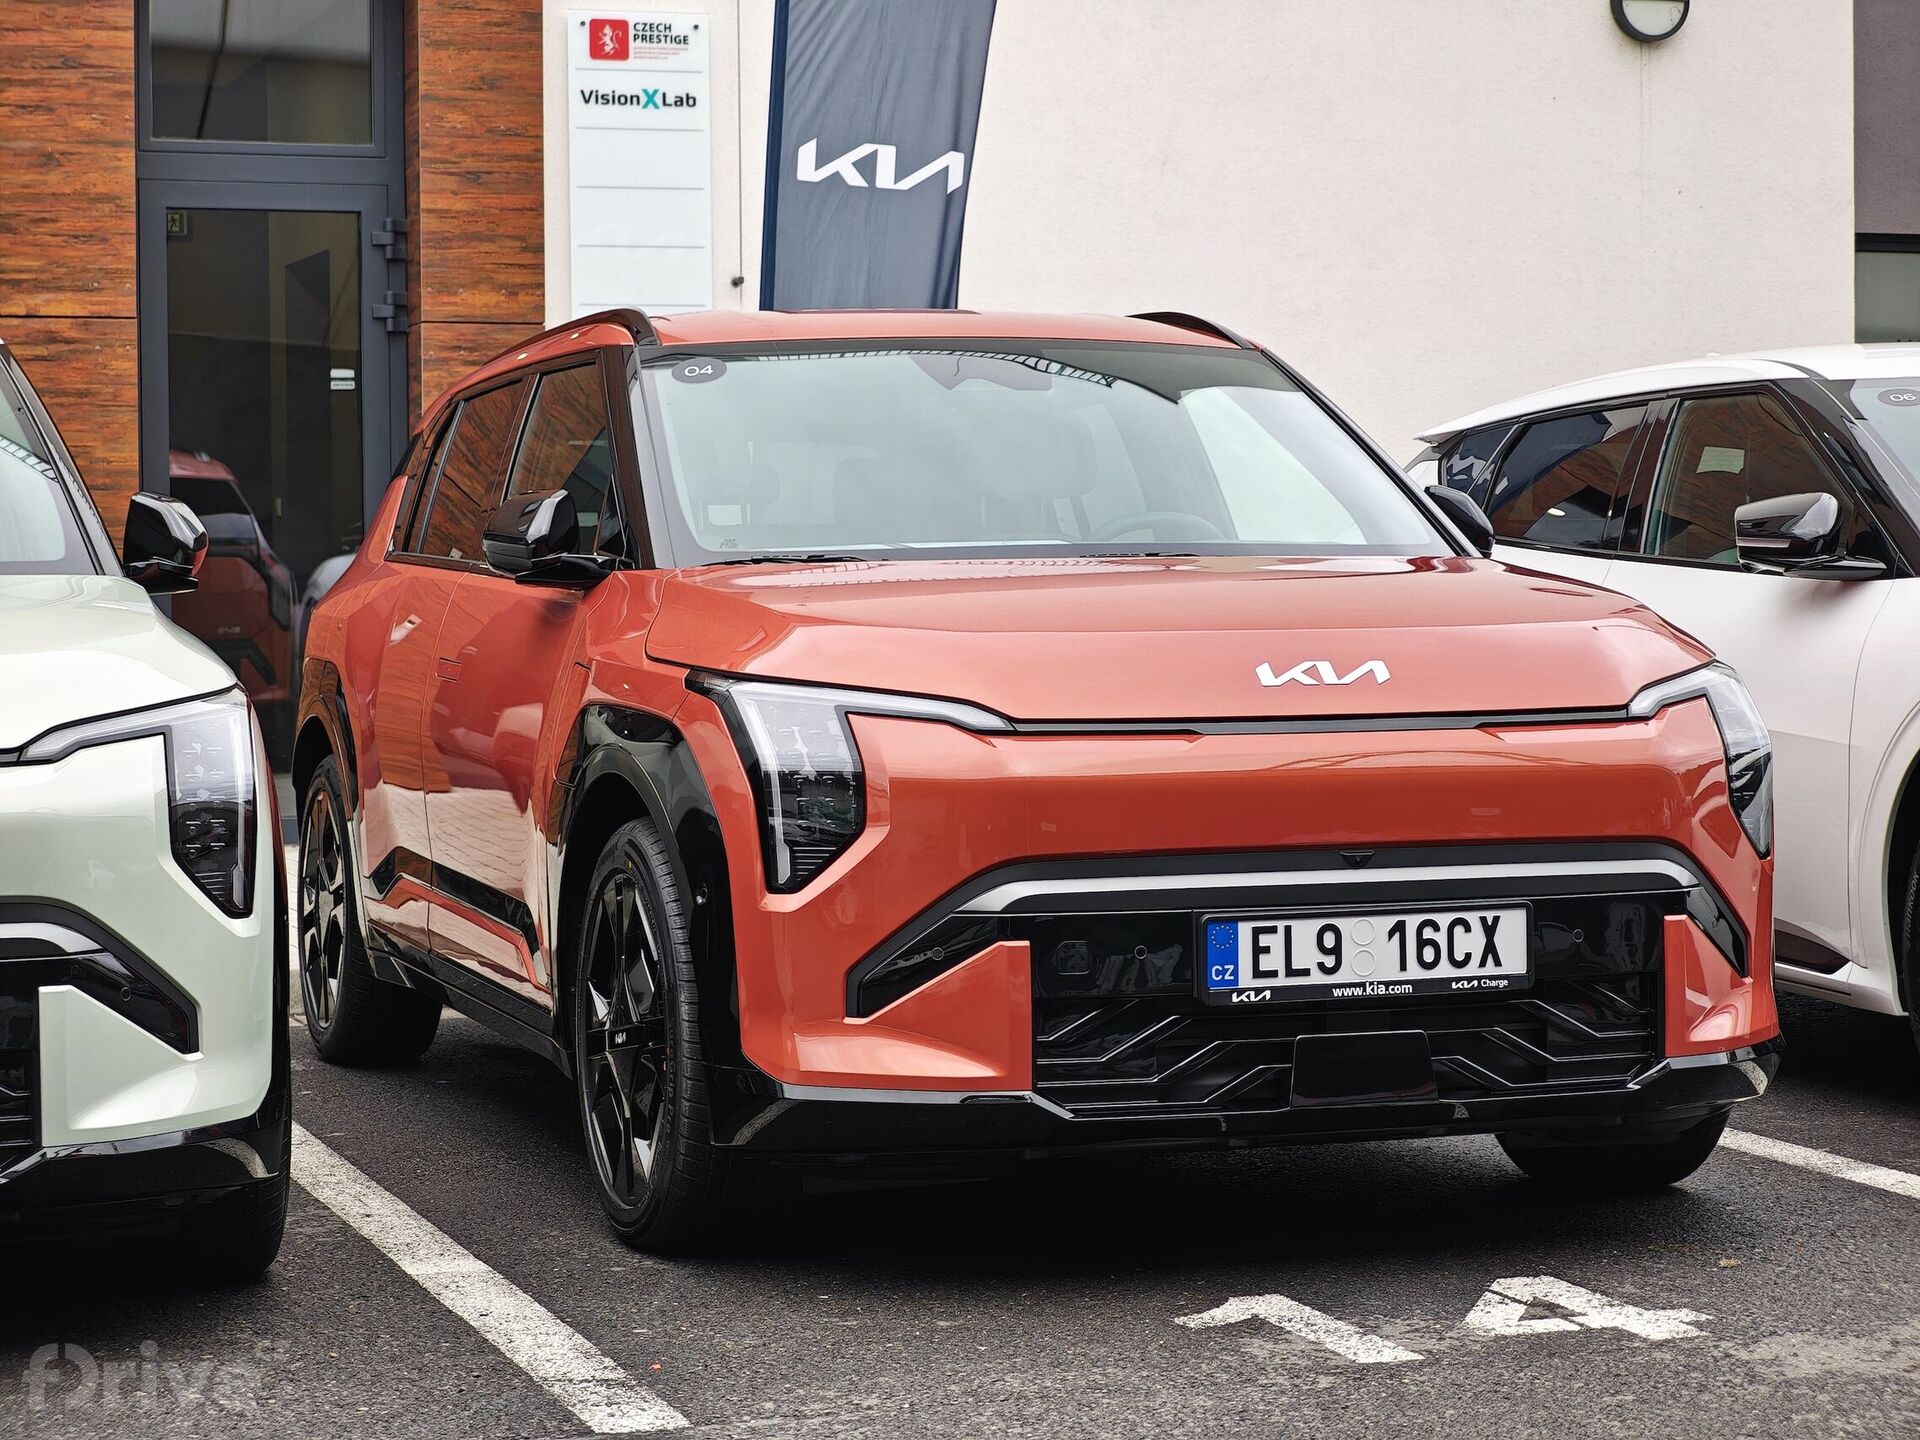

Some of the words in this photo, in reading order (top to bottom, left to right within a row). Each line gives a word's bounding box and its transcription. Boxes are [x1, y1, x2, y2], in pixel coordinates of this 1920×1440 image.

[633, 22, 672, 33] CZECH
[633, 34, 689, 45] PRESTIGE
[580, 88, 697, 109] VisionXLab
[797, 137, 965, 194] KIA
[684, 365, 714, 377] 04
[1255, 660, 1391, 687] KIA
[1251, 922, 1343, 979] EL9
[1387, 915, 1503, 972] 16CX
[1212, 965, 1235, 980] CZ
[1231, 990, 1271, 1003] KIA
[1332, 982, 1413, 997] www.kia.com
[1451, 980, 1479, 989] KIA
[1481, 979, 1509, 988] Charge
